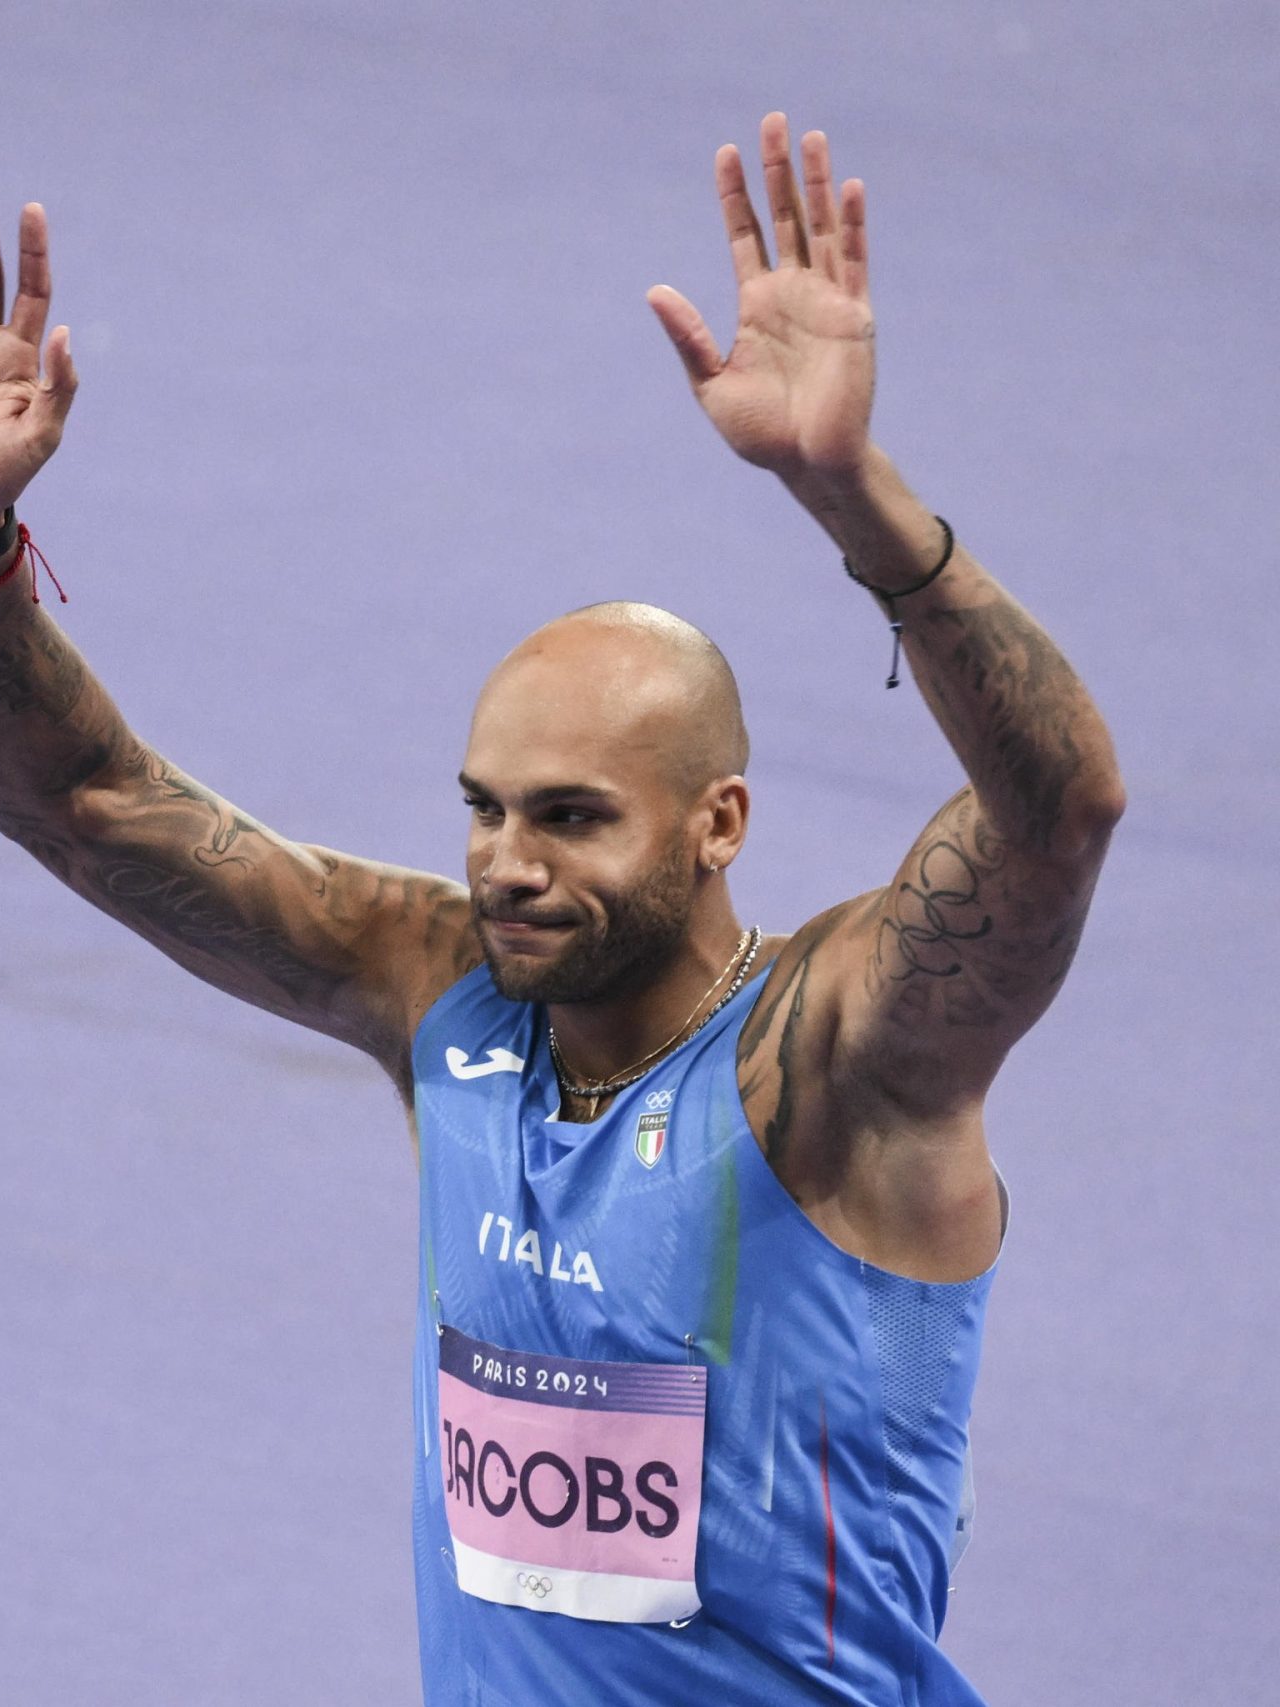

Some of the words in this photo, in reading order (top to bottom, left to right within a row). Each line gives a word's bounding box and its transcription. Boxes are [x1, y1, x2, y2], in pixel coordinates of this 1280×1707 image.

[640, 1114, 668, 1125] ITALIA
[536, 1369, 607, 1397] 2024
[443, 1418, 680, 1538] JACOBS
